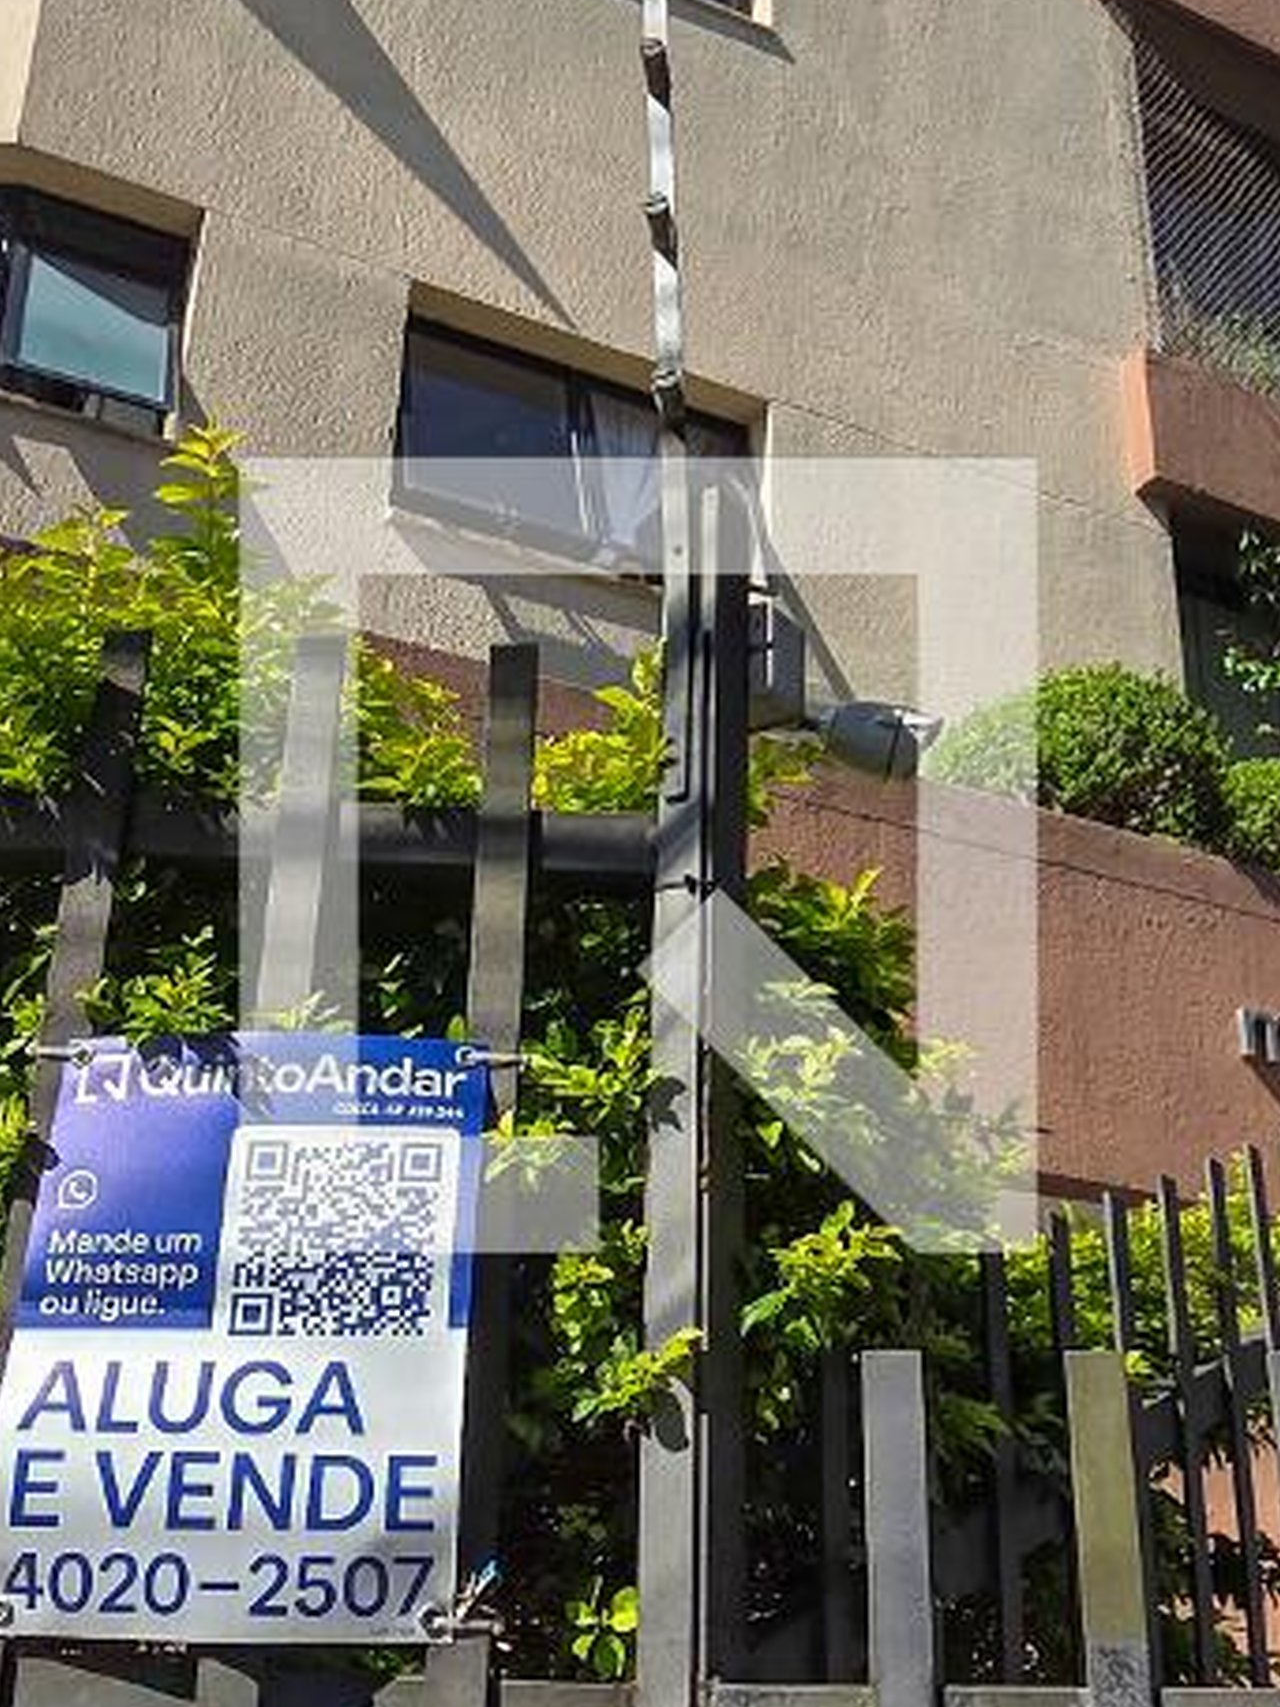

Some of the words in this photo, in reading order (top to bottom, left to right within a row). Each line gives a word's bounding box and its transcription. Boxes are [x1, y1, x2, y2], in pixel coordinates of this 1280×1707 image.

[47, 1229, 149, 1254] Mande
[154, 1232, 202, 1254] um
[46, 1259, 200, 1290] Whatsapp
[39, 1294, 79, 1315] ou
[84, 1289, 166, 1322] ligue.
[17, 1360, 365, 1436] ALUGA
[8, 1448, 66, 1529] E
[95, 1450, 438, 1532] VENDE
[4, 1551, 436, 1619] 4020-2507
